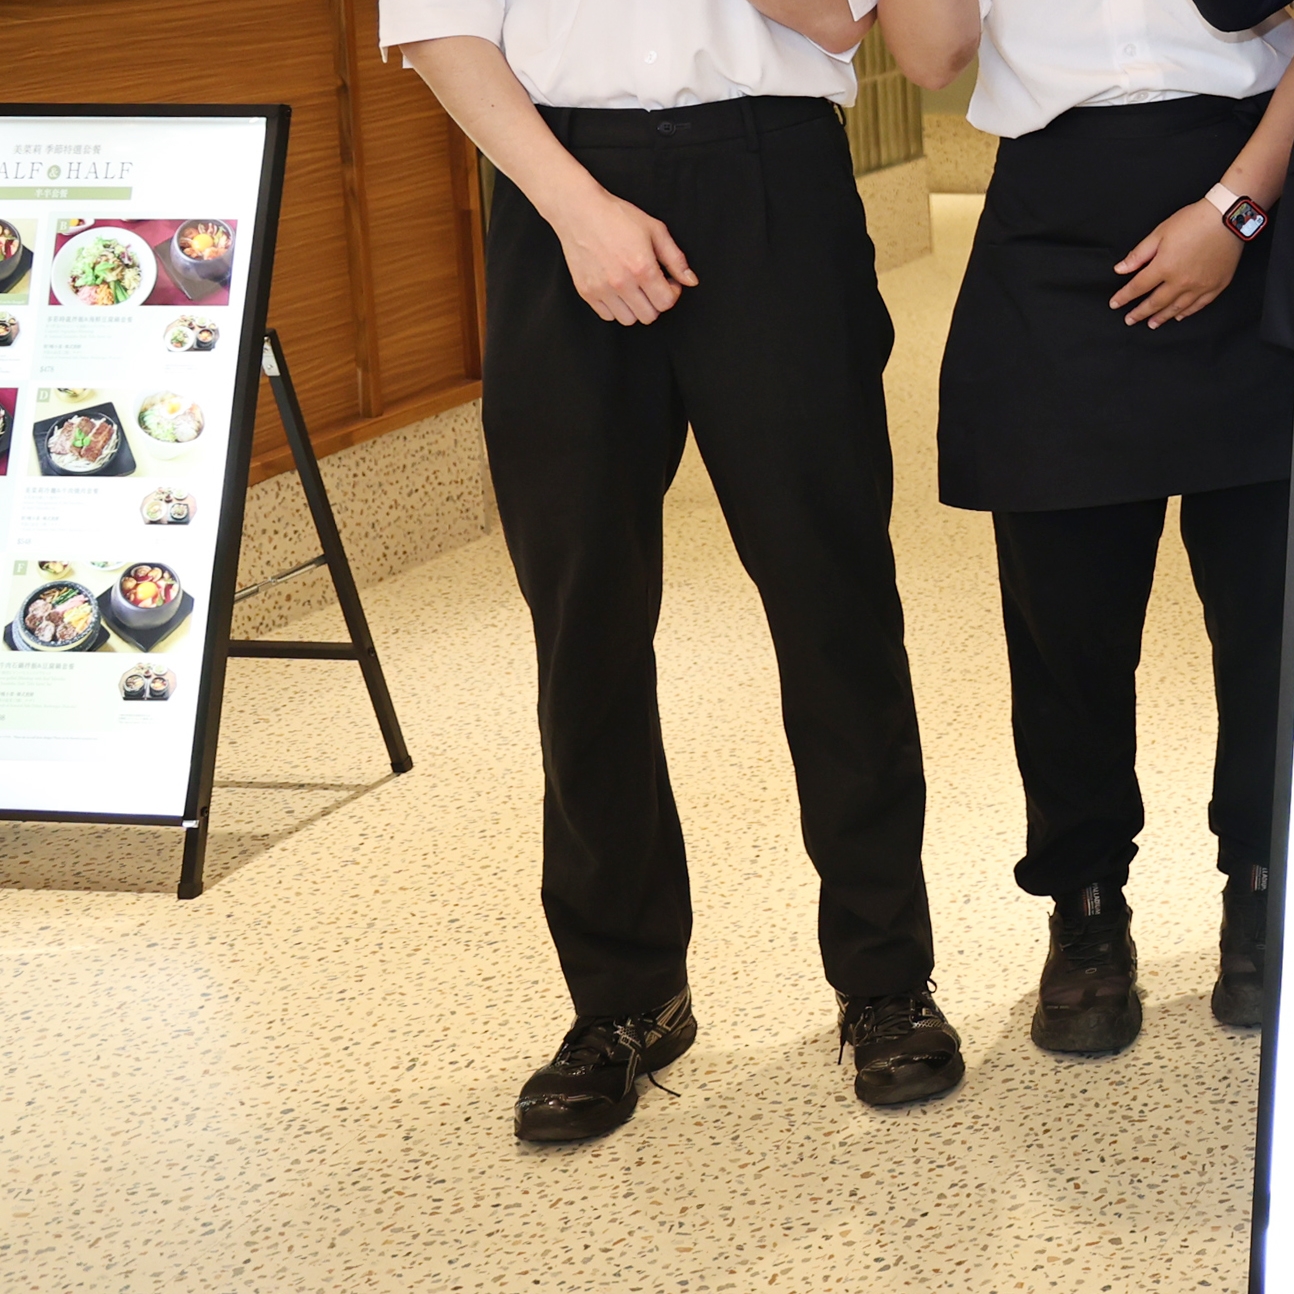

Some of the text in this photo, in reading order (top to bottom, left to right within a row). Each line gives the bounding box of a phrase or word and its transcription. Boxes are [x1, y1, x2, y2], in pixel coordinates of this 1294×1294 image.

[66, 161, 134, 179] HALF
[58, 220, 69, 232] B
[38, 389, 49, 402] D
[16, 562, 25, 575] F
